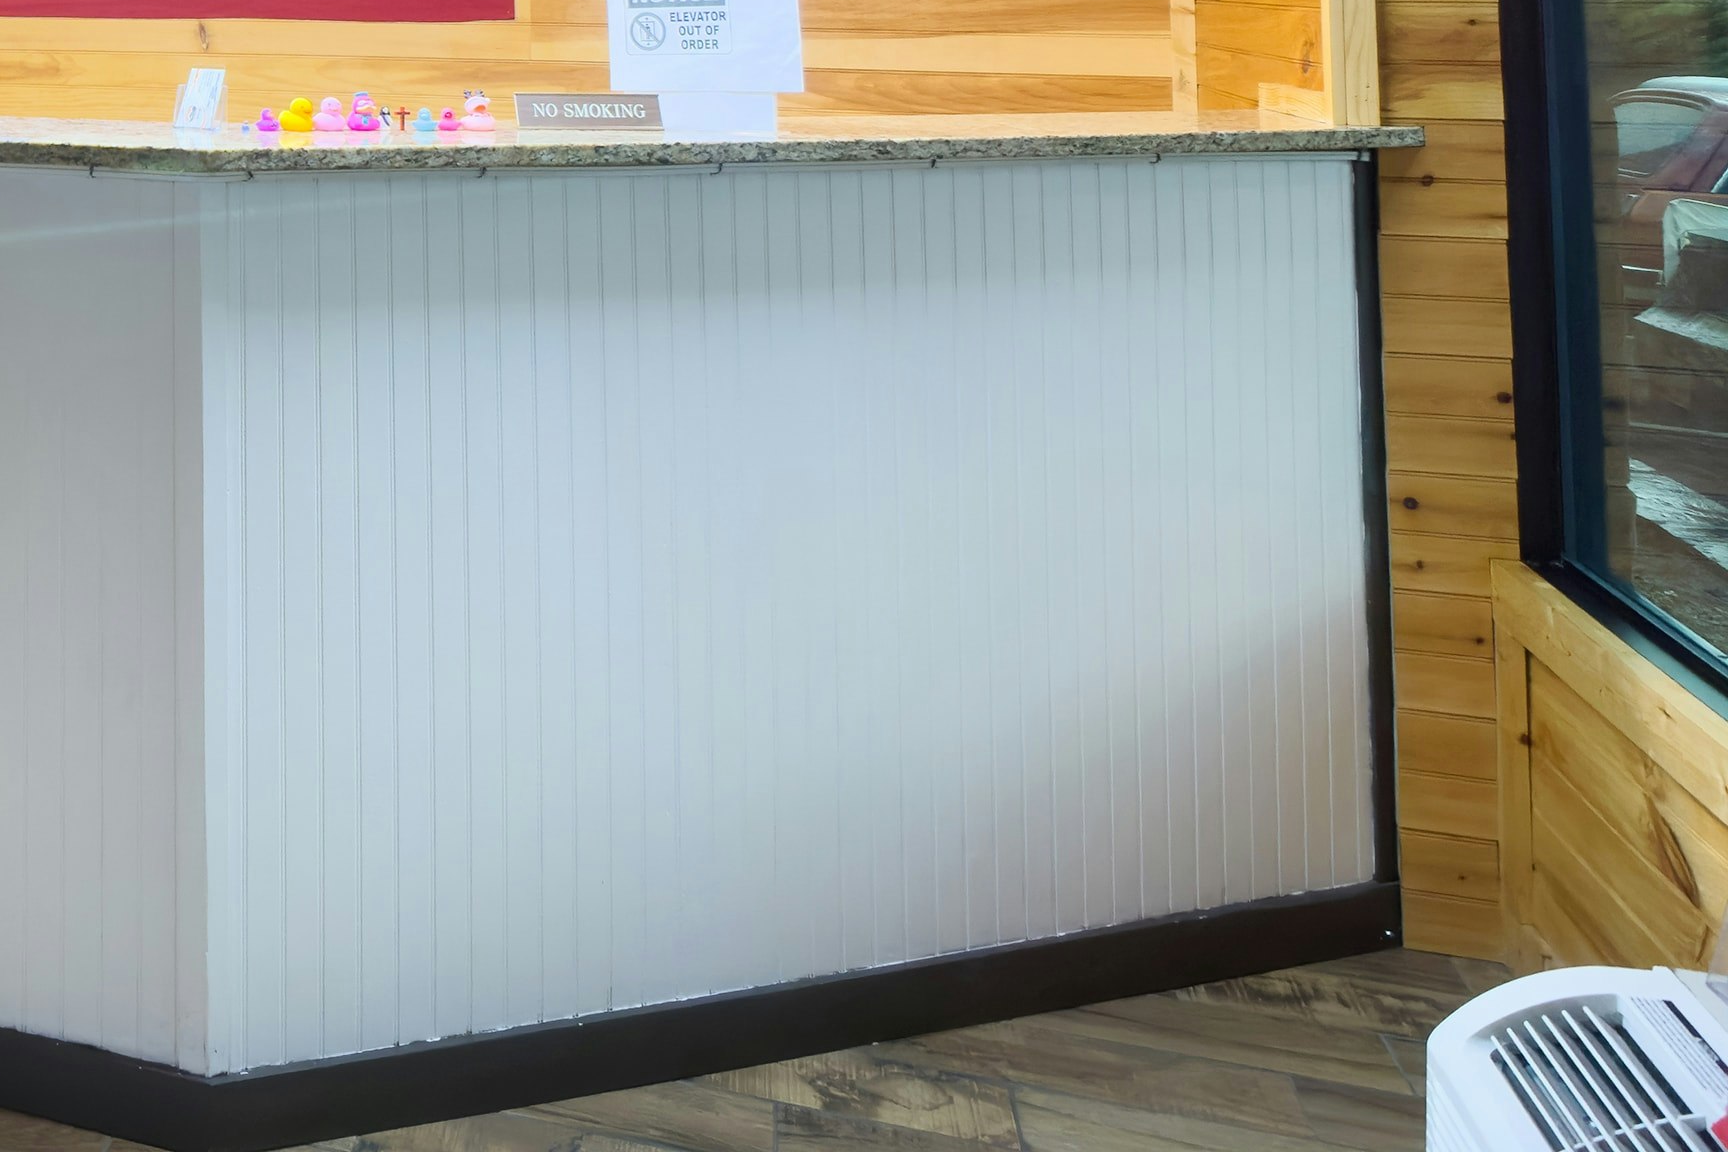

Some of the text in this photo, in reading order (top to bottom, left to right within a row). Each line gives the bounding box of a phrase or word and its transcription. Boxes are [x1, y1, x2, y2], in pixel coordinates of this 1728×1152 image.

[669, 11, 727, 23] ELEVATOR
[678, 25, 720, 36] OUT OF
[680, 39, 719, 50] ORDER
[531, 102, 647, 120] NO SMOKING
